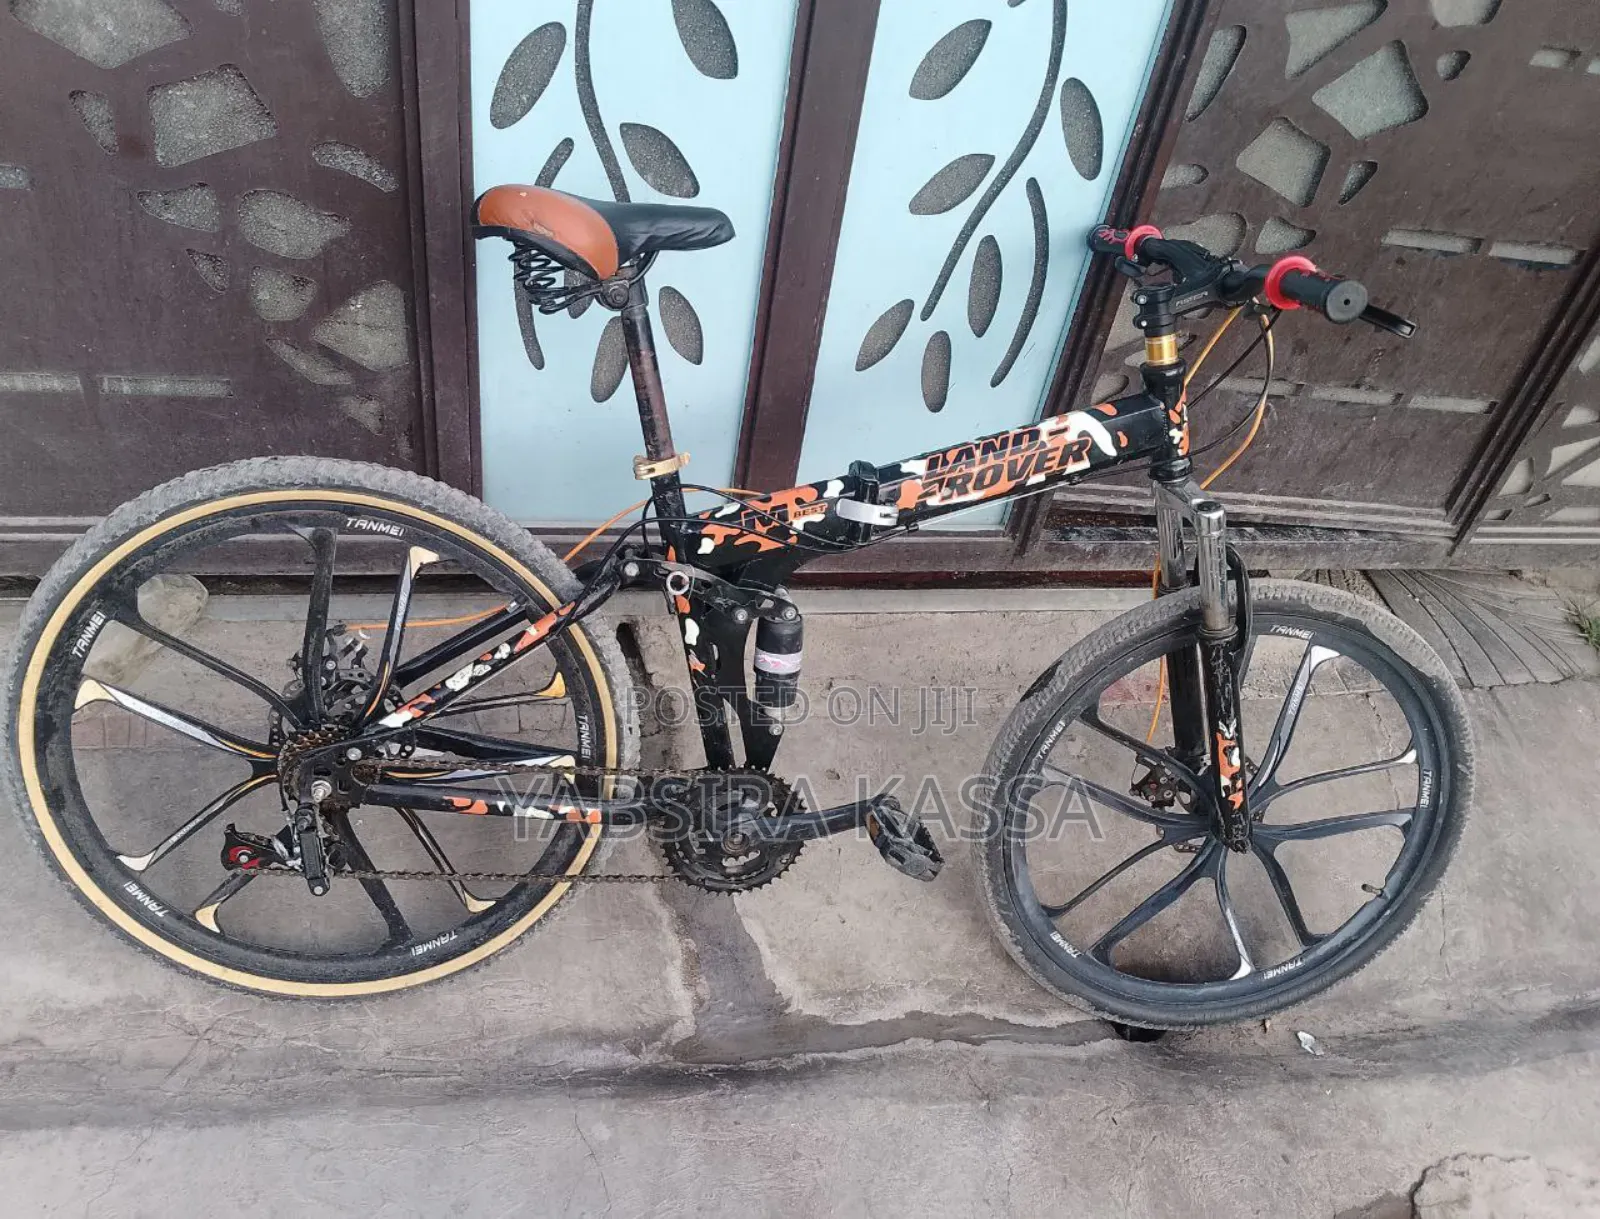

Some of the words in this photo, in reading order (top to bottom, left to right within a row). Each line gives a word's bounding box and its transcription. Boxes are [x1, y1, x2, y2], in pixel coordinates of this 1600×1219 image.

[793, 503, 828, 520] BEST
[345, 515, 405, 538] TANMEI
[72, 611, 106, 658] TANMEI
[1270, 623, 1314, 640] TANMEI
[577, 713, 592, 760] TANMEI
[1034, 720, 1066, 761] TANMEI
[1418, 770, 1432, 811] TANMEI
[122, 880, 170, 918] TANMEI
[411, 931, 459, 958] TANMEI
[1049, 931, 1081, 959] TANMEI
[1262, 957, 1306, 980] TANMEI
